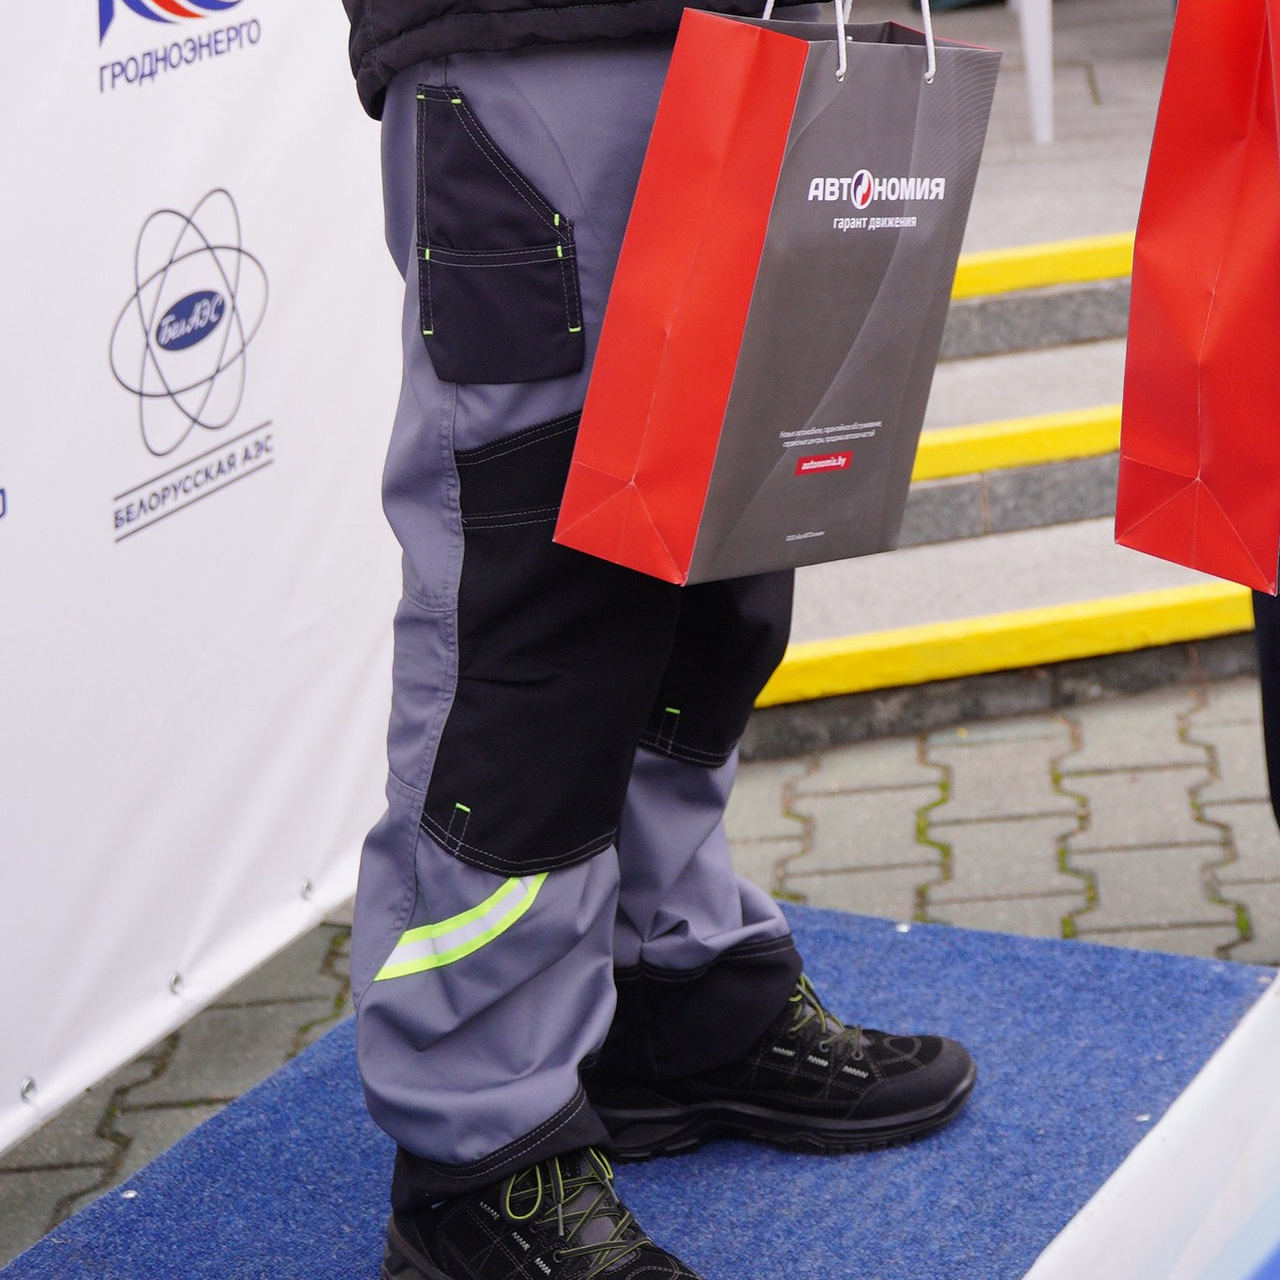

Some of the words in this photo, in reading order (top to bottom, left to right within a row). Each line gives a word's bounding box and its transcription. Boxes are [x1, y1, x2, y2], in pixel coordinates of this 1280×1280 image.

[99, 19, 261, 93] ГРОДНОЭНЕРГО
[808, 169, 946, 210] АВТОНОМИЯ
[833, 217, 867, 232] гарант
[868, 216, 917, 230] движения
[113, 453, 236, 530] БЕЛОРУССКАЯ
[241, 434, 273, 467] АЭС
